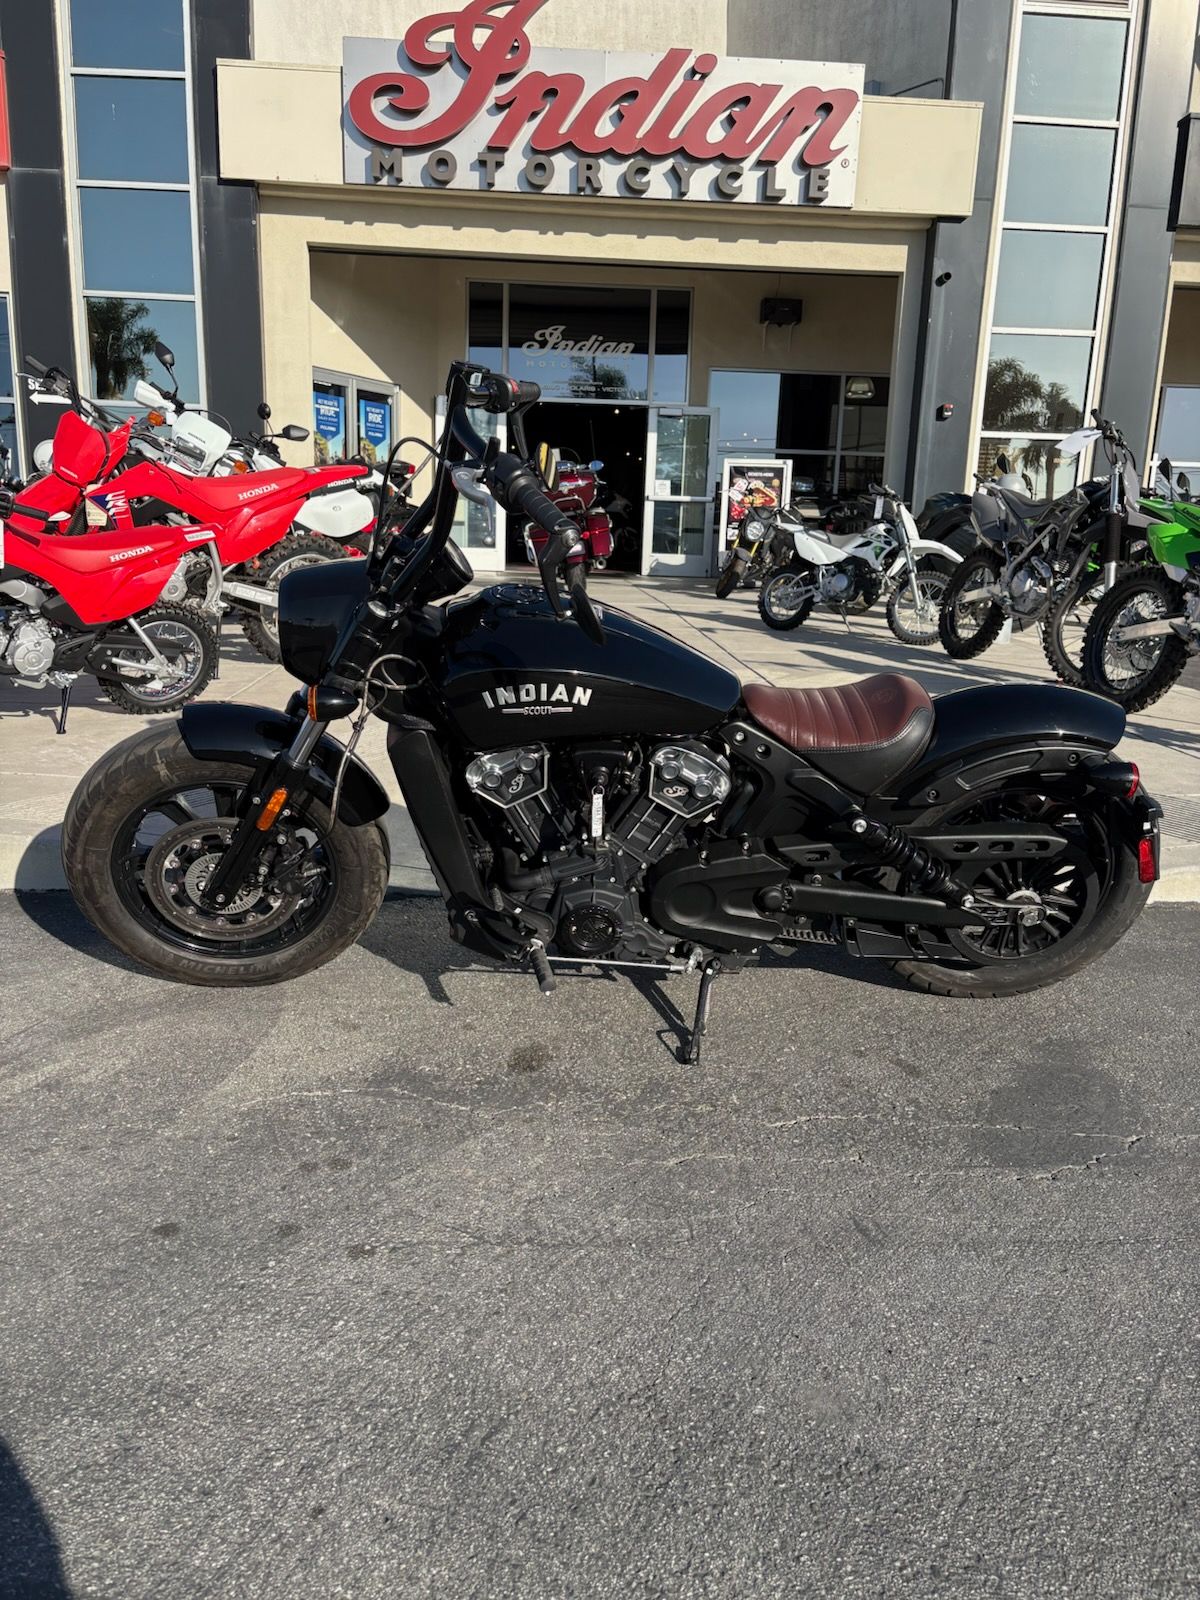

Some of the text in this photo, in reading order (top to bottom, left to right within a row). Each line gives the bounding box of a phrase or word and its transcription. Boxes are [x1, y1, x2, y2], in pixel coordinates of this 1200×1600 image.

[349, 0, 859, 167] Indian
[370, 148, 832, 206] MOTORCYCLE
[521, 325, 636, 357] Indian
[526, 360, 630, 371] MOTORCCE
[237, 482, 280, 501] HONDA
[327, 477, 354, 488] HONDA
[109, 545, 153, 563] HONDA
[481, 683, 592, 709] INDIAN
[523, 706, 552, 715] SCOUT
[178, 958, 270, 976] MICHELIN
